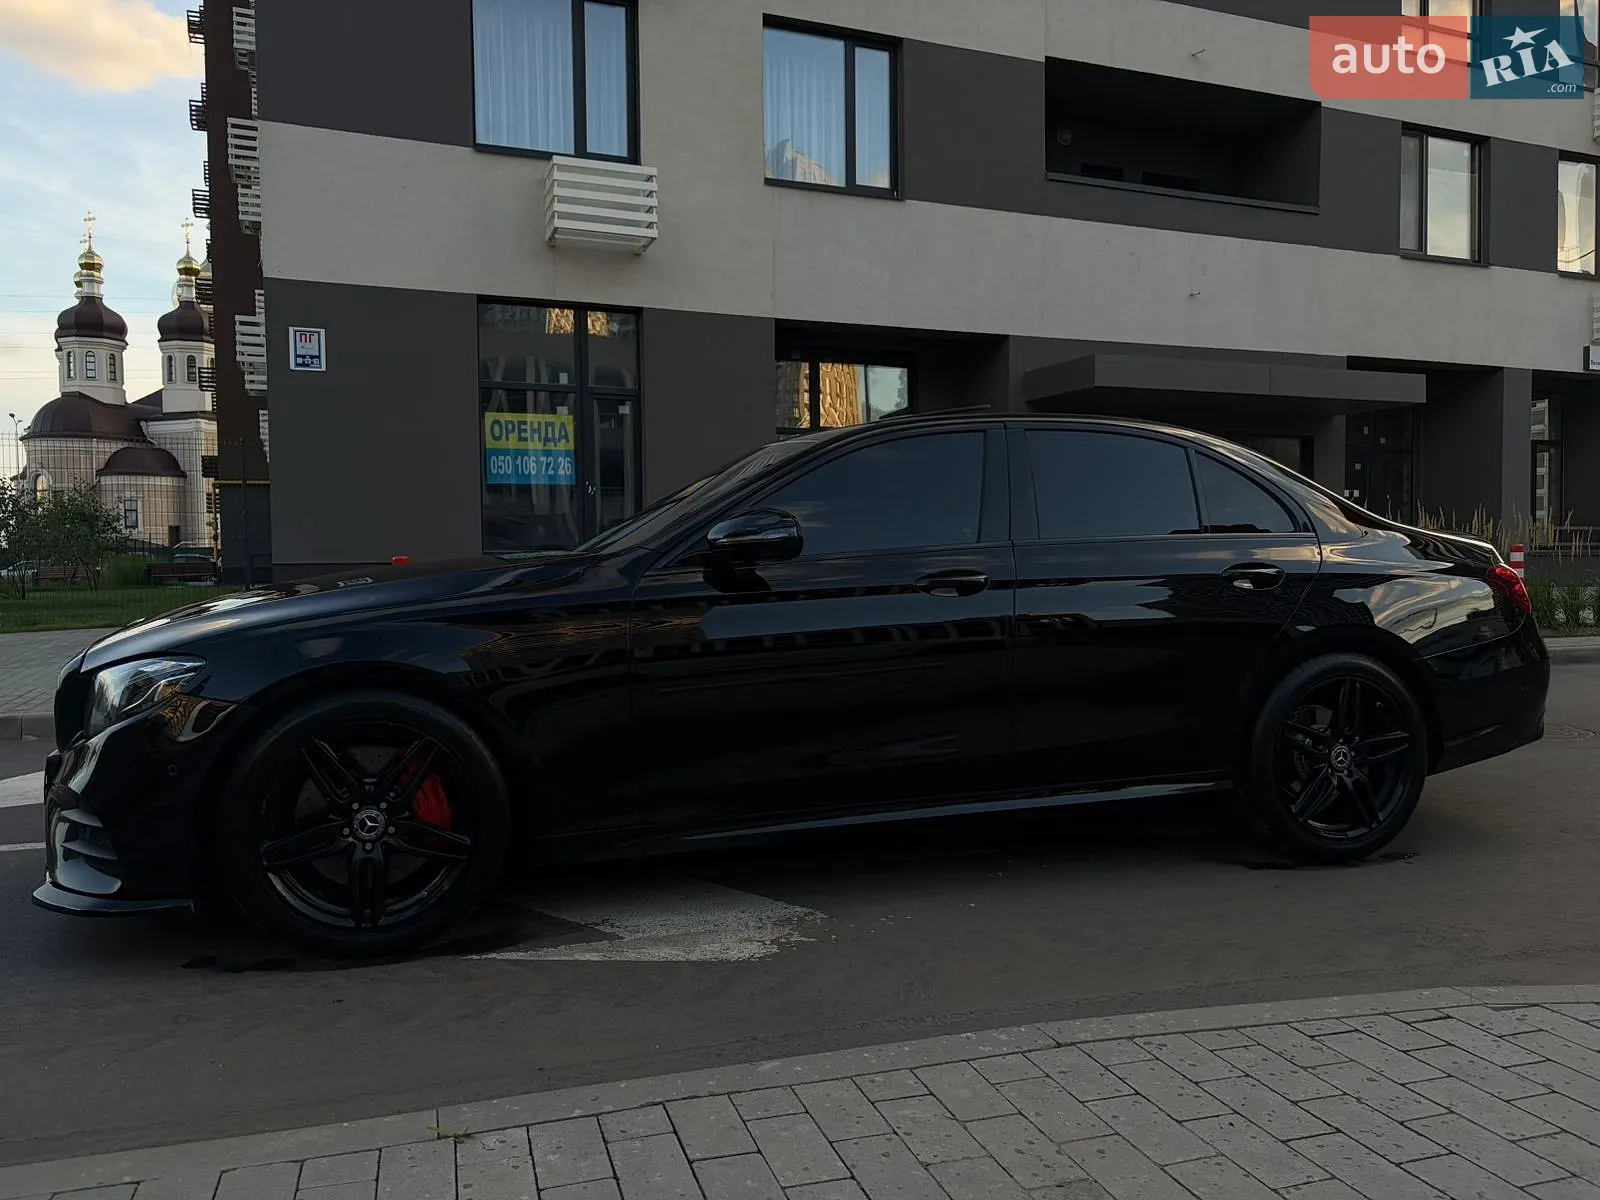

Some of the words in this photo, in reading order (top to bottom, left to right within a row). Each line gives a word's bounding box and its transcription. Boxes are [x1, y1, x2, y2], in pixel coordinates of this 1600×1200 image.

[490, 419, 570, 447] ОРЕНДА
[491, 455, 512, 474] 050
[516, 456, 536, 475] 106
[540, 457, 555, 475] 72
[558, 457, 572, 475] 26
